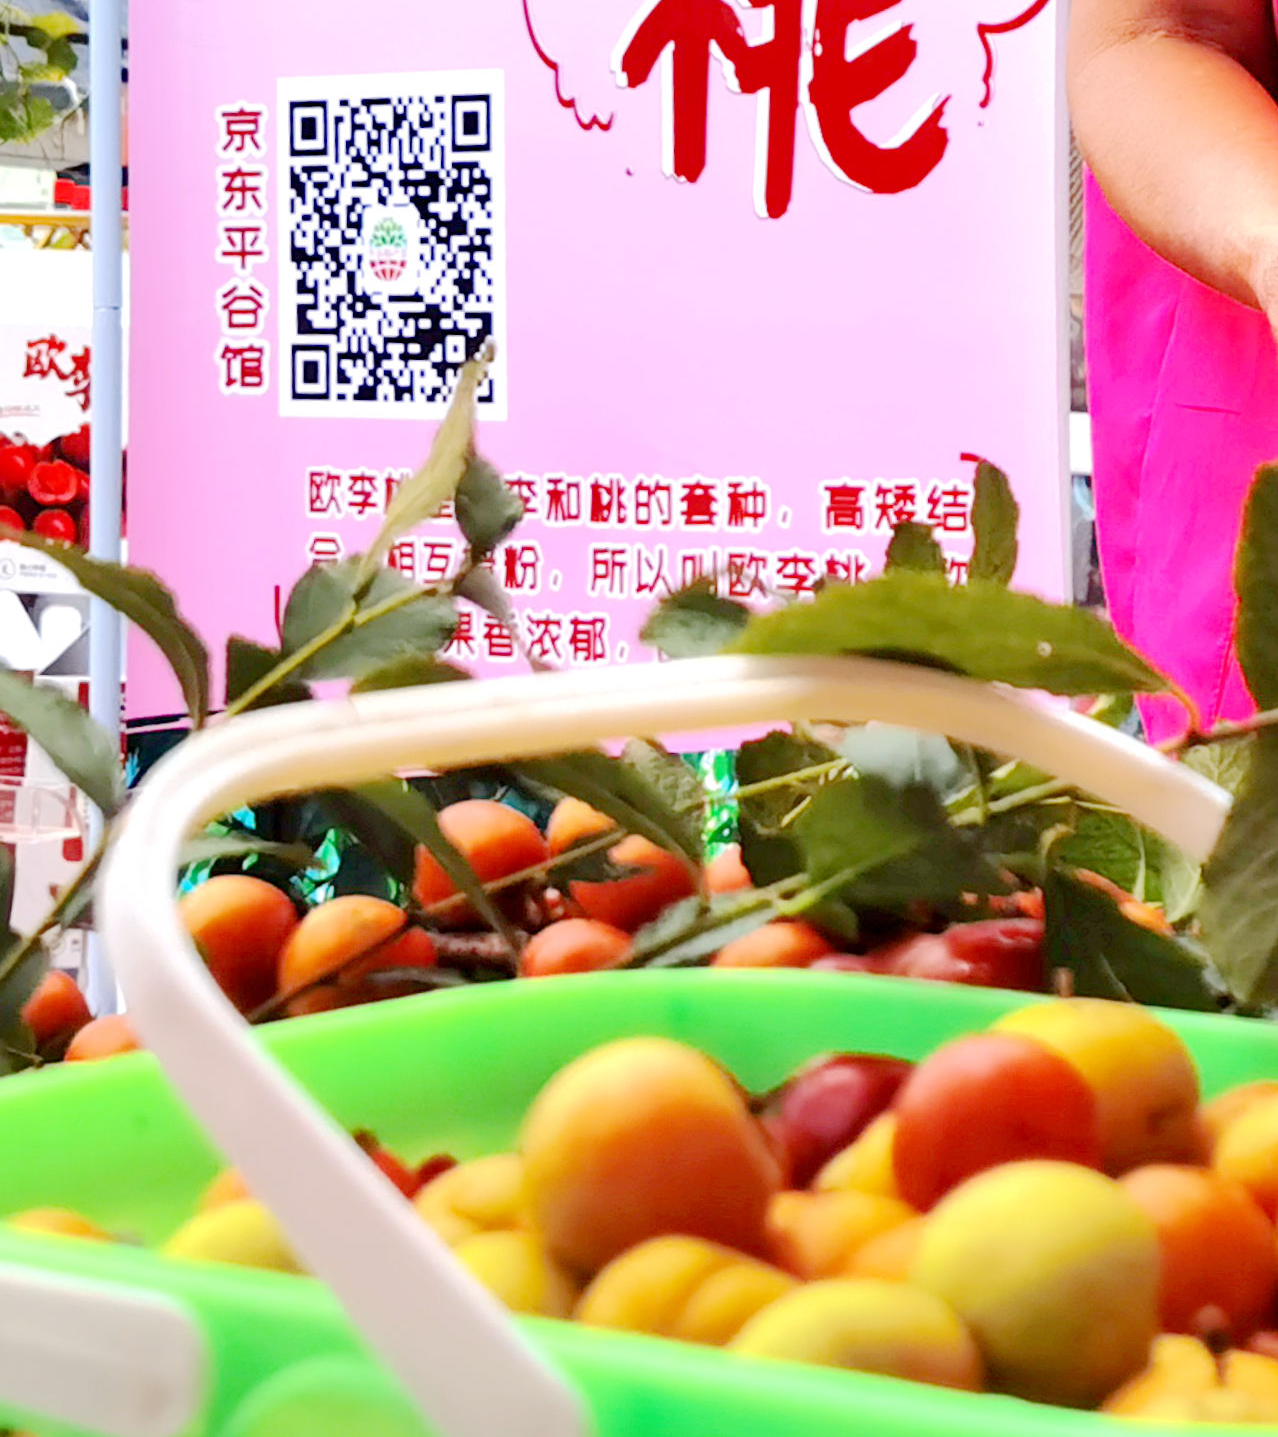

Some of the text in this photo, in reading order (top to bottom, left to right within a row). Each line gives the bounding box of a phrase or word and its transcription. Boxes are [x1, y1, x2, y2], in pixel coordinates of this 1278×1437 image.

[218, 106, 267, 393] 京东平谷馆
